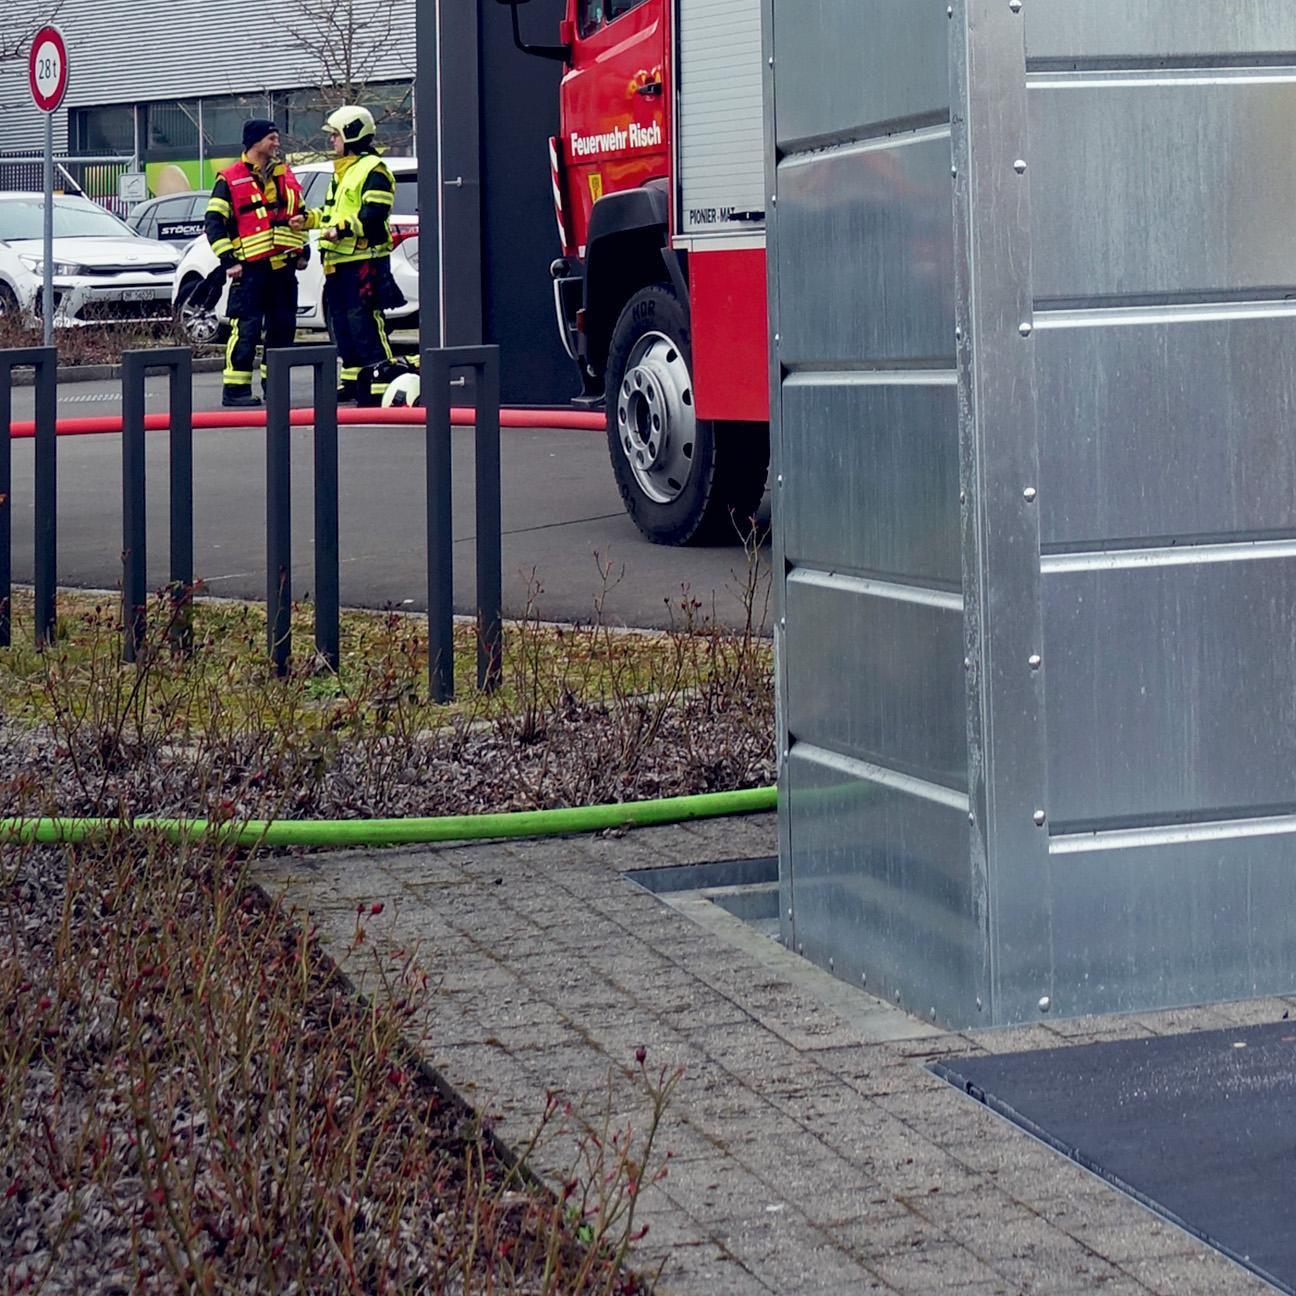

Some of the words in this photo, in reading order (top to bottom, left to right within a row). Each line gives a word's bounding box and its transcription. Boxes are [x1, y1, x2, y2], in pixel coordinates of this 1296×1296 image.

[39, 58, 51, 79] 28
[570, 125, 628, 157] Feuerwehr
[628, 119, 662, 148] Risch
